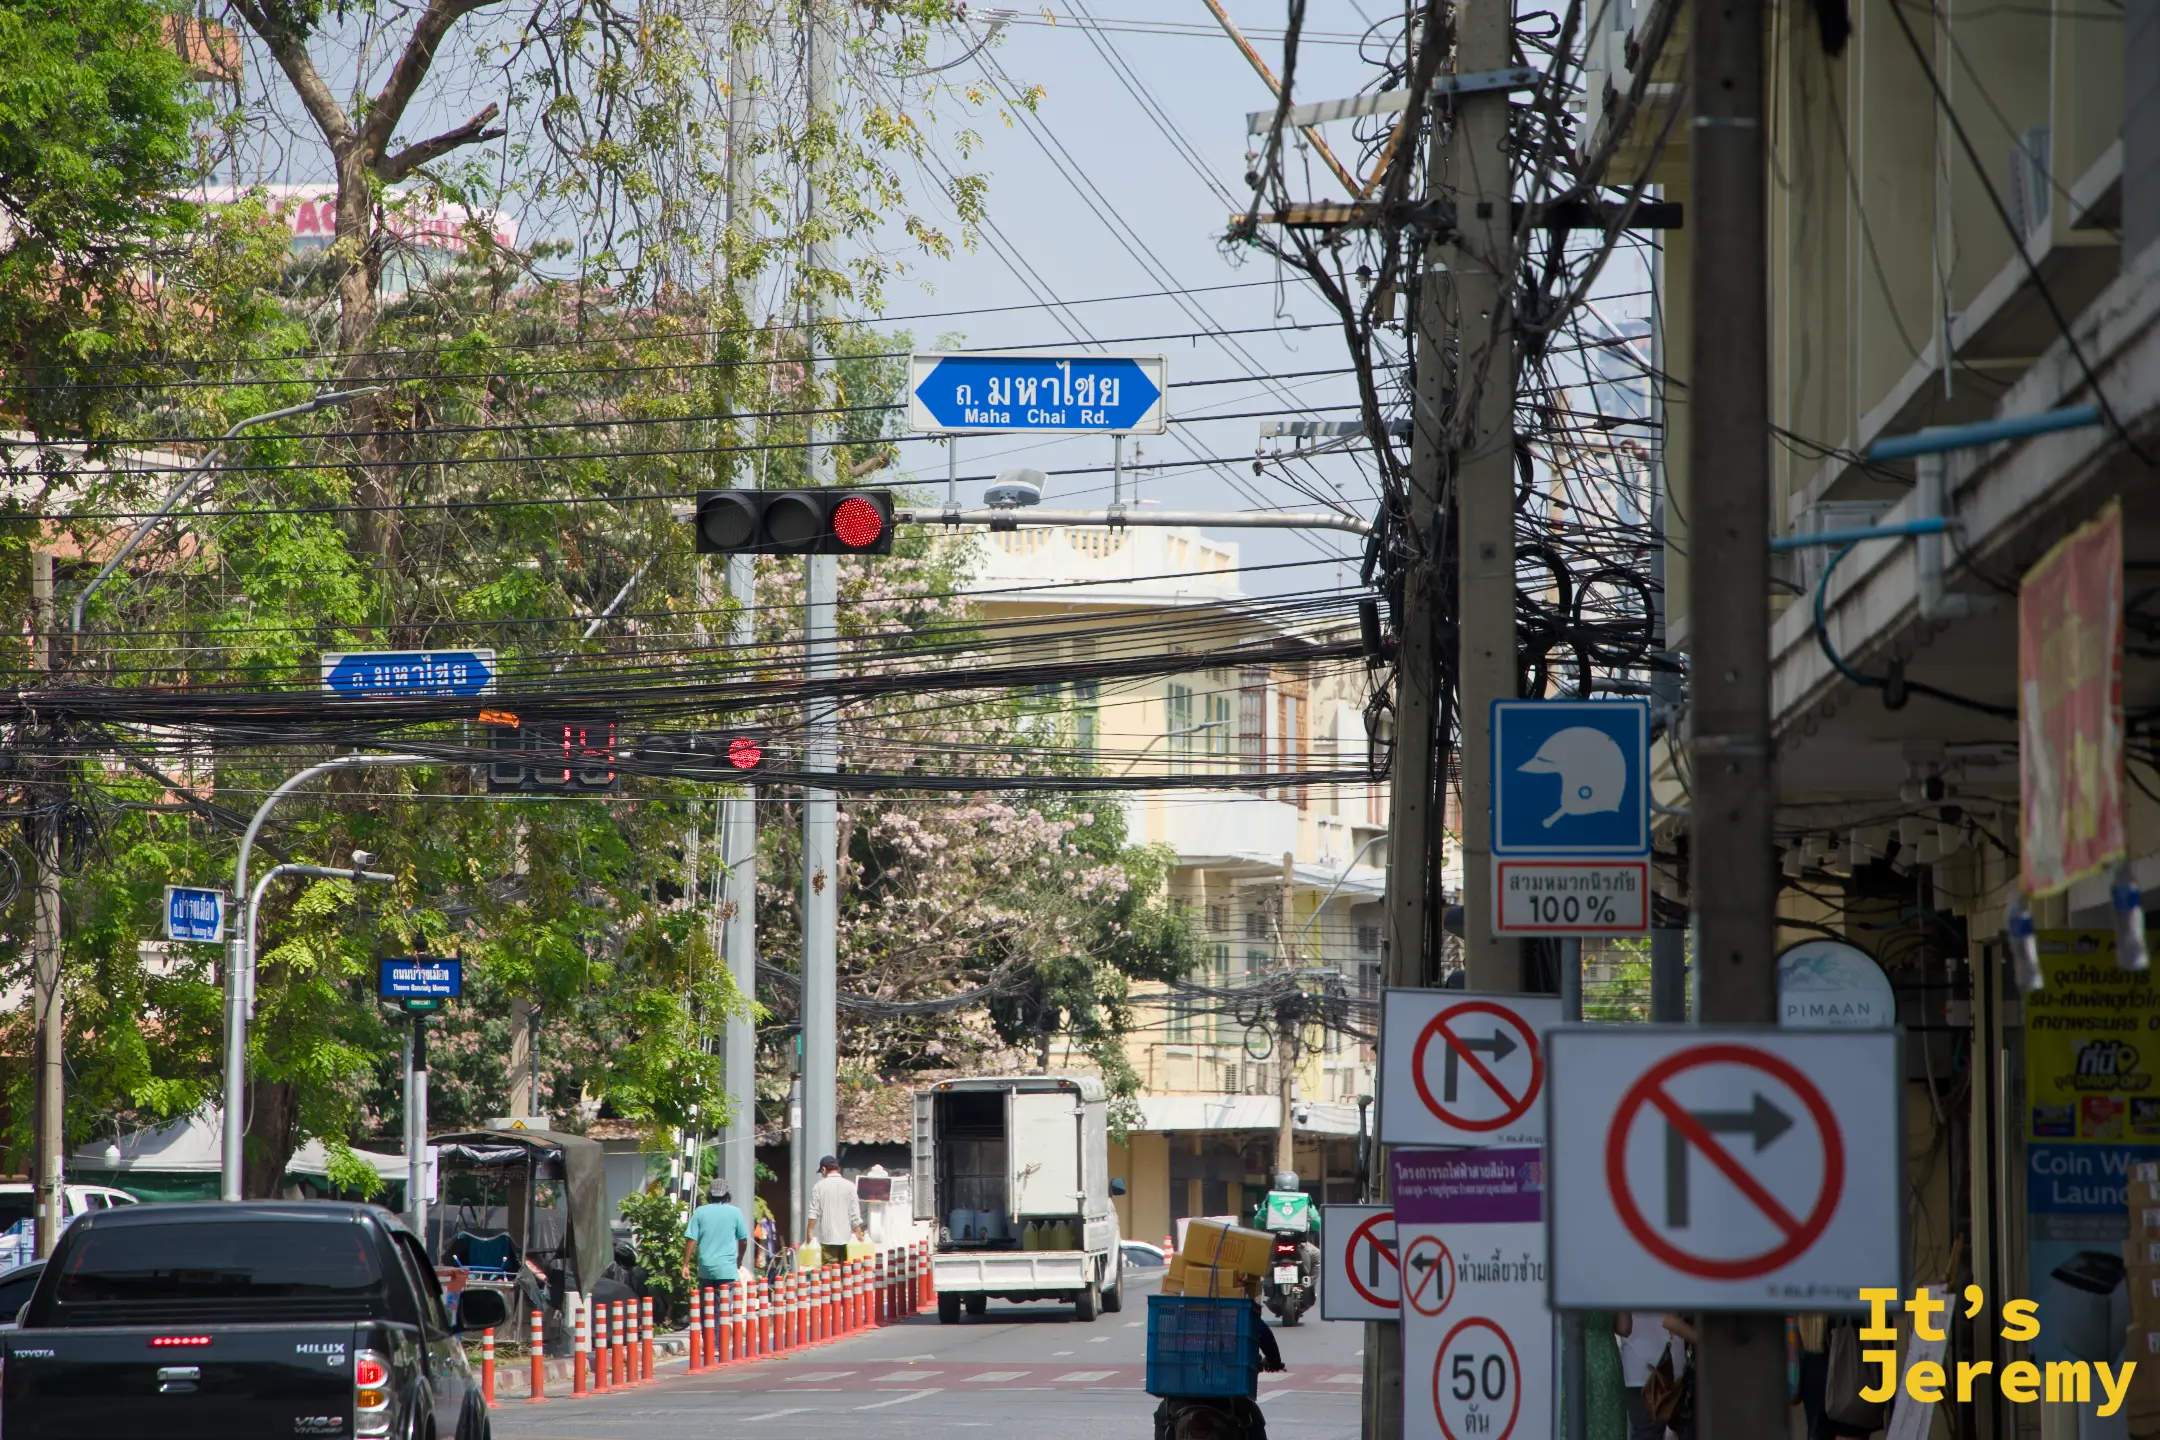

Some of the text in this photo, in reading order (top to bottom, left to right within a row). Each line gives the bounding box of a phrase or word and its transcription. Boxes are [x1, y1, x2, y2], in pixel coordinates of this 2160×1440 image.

[956, 360, 1120, 406] ถ. มหาไชย
[965, 408, 1110, 425] Maha Chai Rd.
[1509, 871, 1636, 892] สวมหมวกนิรภัย
[1787, 1001, 1871, 1018] PIMAAN
[2031, 1149, 2093, 1176] Coin
[13, 1349, 56, 1358] TOYOTA
[296, 1343, 345, 1354] HILUX
[1452, 1353, 1507, 1402] 50
[1465, 1403, 1490, 1434] ตัน
